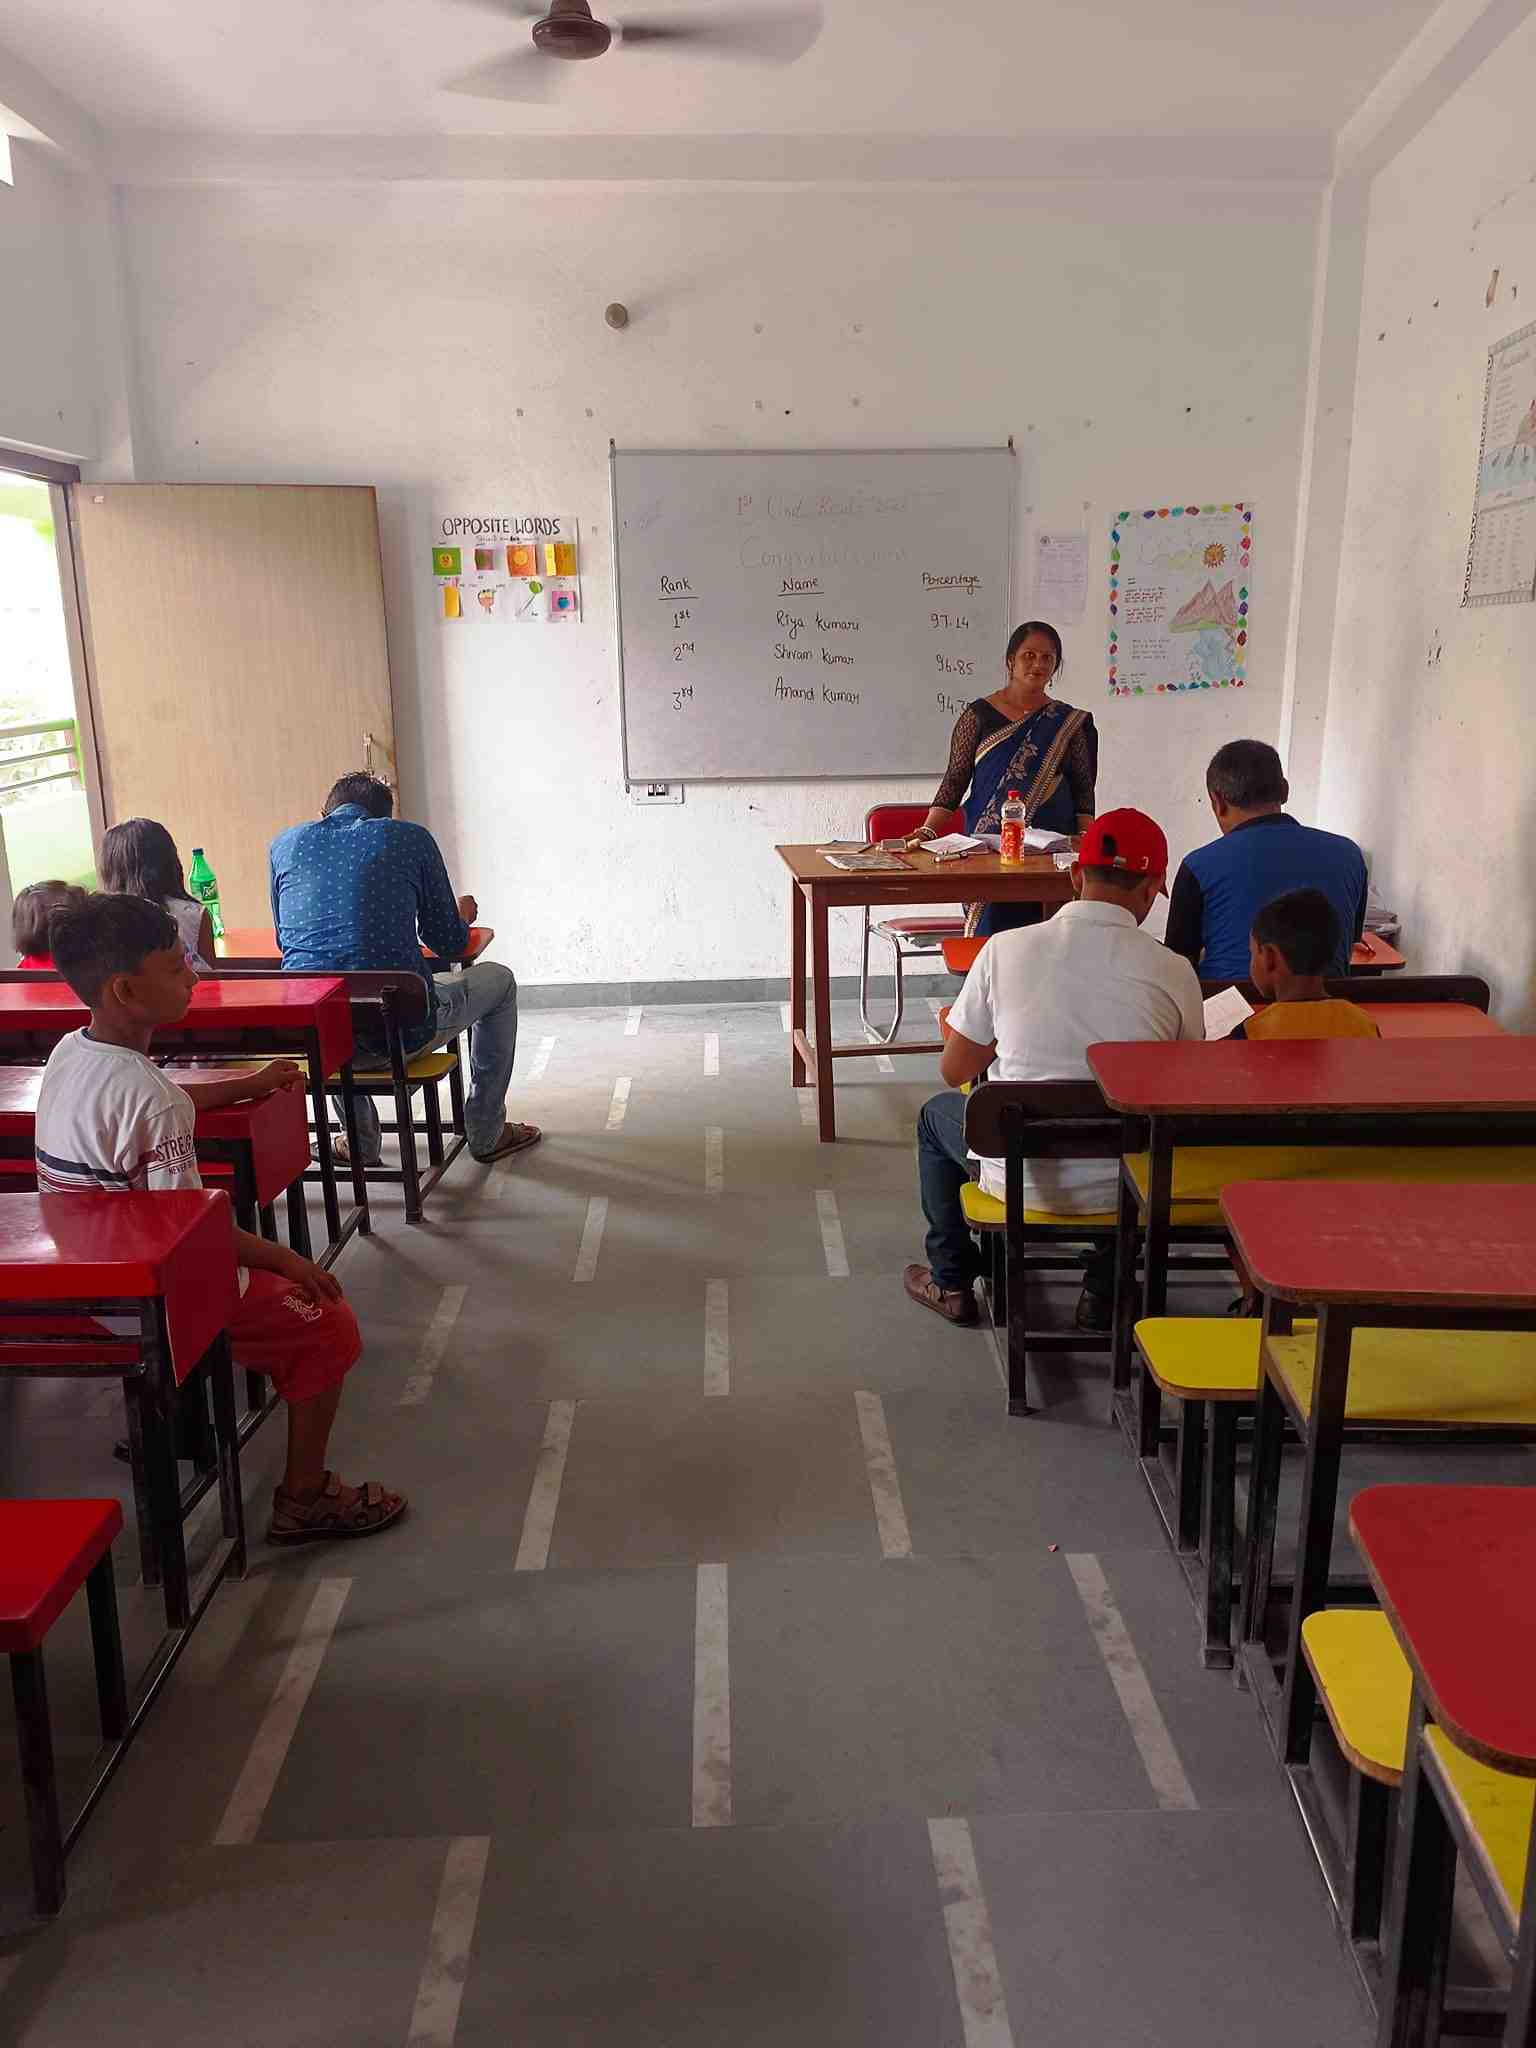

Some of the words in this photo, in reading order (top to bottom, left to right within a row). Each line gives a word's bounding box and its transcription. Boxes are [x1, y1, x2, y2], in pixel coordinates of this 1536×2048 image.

[442, 518, 510, 536] OPPOSITE
[515, 518, 561, 536] WORDS
[661, 575, 692, 594] Rank
[782, 578, 819, 593] Name
[674, 609, 692, 629] 1st
[776, 609, 805, 640] Riya
[931, 612, 969, 629] 97.14
[674, 642, 696, 661] 2nd
[672, 686, 694, 711] 3rd
[775, 675, 815, 702] Anand
